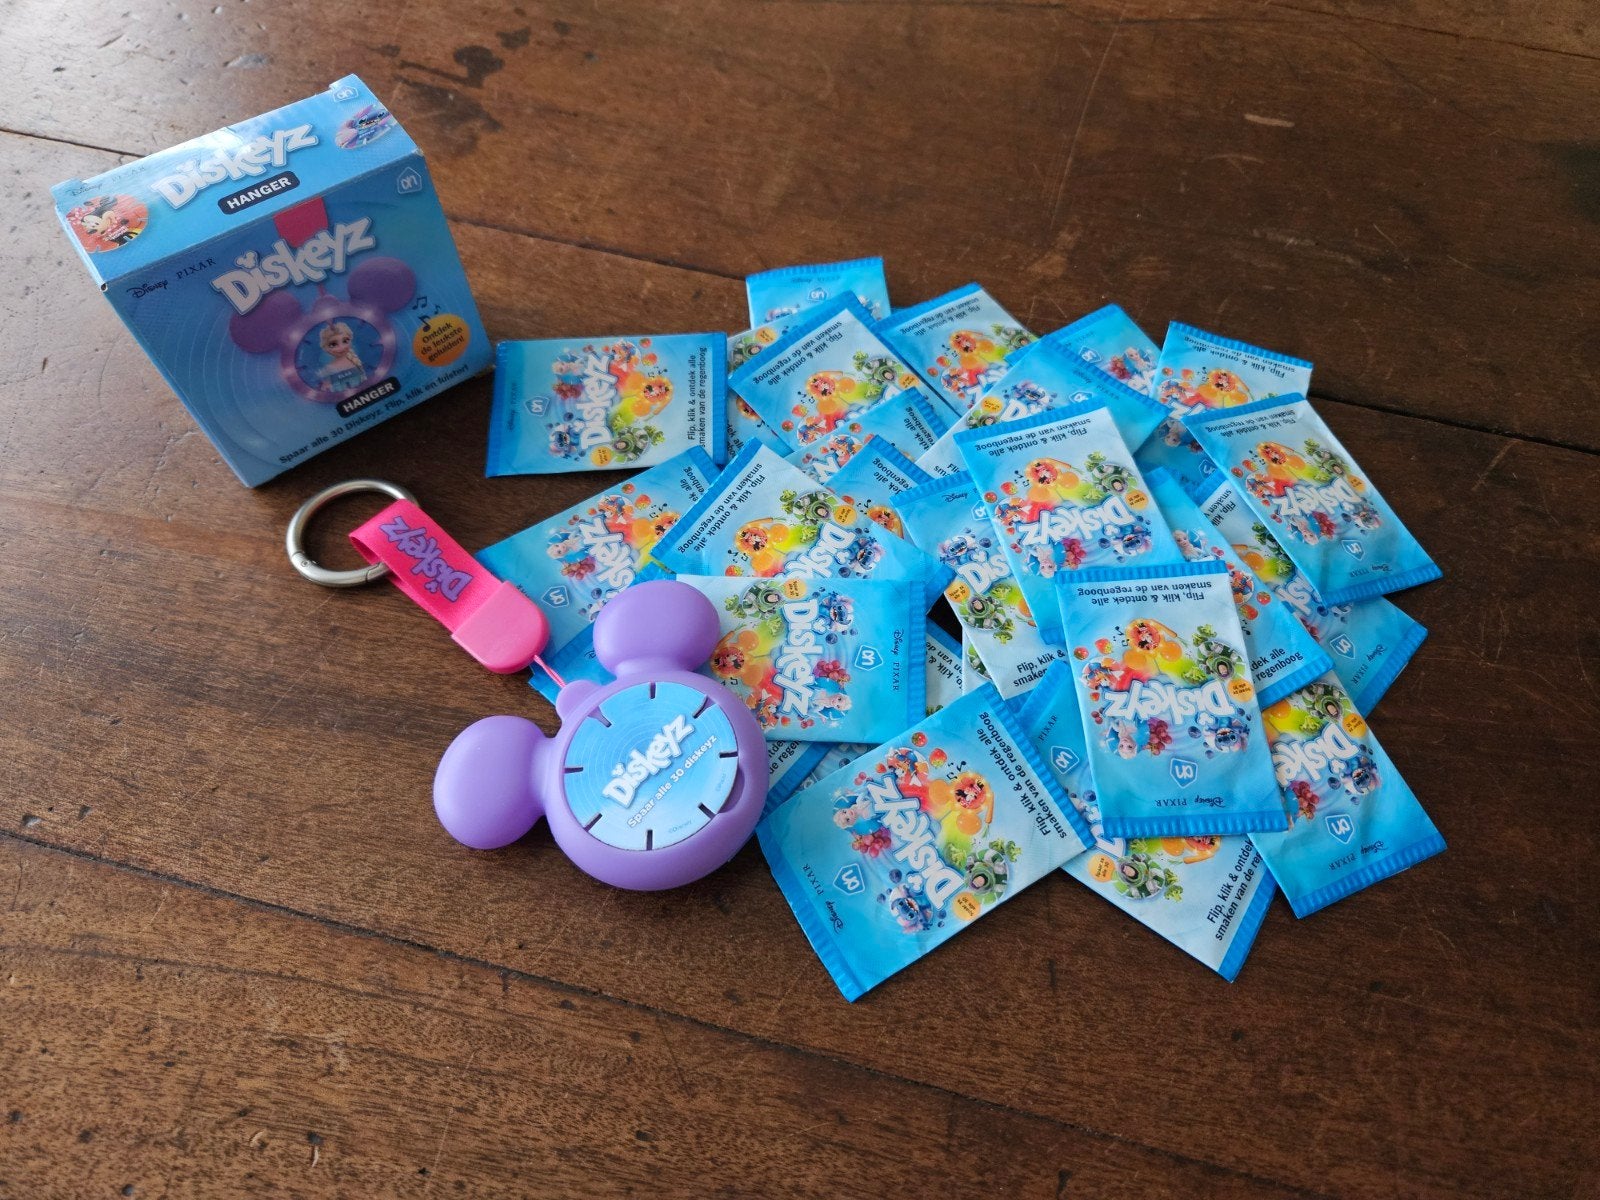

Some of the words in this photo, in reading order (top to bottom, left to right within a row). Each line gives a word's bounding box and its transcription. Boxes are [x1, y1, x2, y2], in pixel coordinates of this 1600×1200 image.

[149, 124, 319, 210] Diskeyz
[226, 176, 292, 210] HANGER
[209, 216, 376, 315] Diskeyz
[126, 279, 169, 298] Disney
[176, 257, 217, 279] PIXAR
[421, 322, 453, 344] Ontdek
[432, 326, 463, 350] leukste
[815, 321, 841, 341] smaken
[826, 330, 842, 344] Flip,
[801, 339, 814, 350] van
[813, 342, 827, 354] klik
[1191, 344, 1206, 353] alle
[687, 354, 696, 368] alle
[1209, 350, 1238, 362] ontdek
[698, 347, 709, 389] regenboog
[752, 355, 791, 384] regenboog
[781, 356, 806, 376] ontdek
[1250, 362, 1265, 371] klik
[1266, 366, 1284, 378] Flip,
[687, 368, 696, 398] ontdek
[767, 374, 781, 386] alle
[342, 382, 395, 413] HANGER
[577, 353, 619, 449] Diskeyz
[279, 444, 309, 464] Spaar
[311, 435, 330, 449] alle
[331, 426, 344, 438] 30
[406, 387, 424, 401] klik
[424, 382, 437, 393] en
[437, 364, 469, 385] luister!
[687, 407, 696, 422] klik
[687, 424, 697, 441] Flip,
[698, 415, 707, 448] smaken
[902, 417, 915, 432] alle
[1037, 427, 1053, 435] van
[1057, 418, 1090, 432] smaken
[1067, 426, 1087, 437] Flip,
[974, 434, 1022, 452] regenboog
[1006, 439, 1038, 452] ontdek
[1025, 432, 1035, 440] de
[1039, 436, 1047, 444] &
[1049, 432, 1065, 441] klik
[988, 447, 1004, 457] alle
[678, 478, 691, 492] alle
[682, 466, 704, 494] enboog
[736, 462, 762, 491] smaken
[749, 473, 765, 490] Flip,
[873, 470, 888, 484] alle
[723, 490, 736, 504] van
[736, 488, 751, 504] klik
[1208, 488, 1232, 513] smaken
[1274, 478, 1361, 517] Diskeyz
[714, 504, 725, 515] de
[730, 503, 738, 511] &
[1219, 500, 1235, 516] Flip,
[707, 510, 731, 537] ontdek
[1017, 495, 1134, 546] Diskeyz
[677, 513, 715, 555] regenboog
[579, 513, 637, 590] skeyz
[693, 537, 708, 552] alle
[784, 522, 856, 579] Disk
[379, 516, 474, 602] Diskeyz
[1077, 584, 1131, 596] regenboog
[1135, 585, 1147, 593] de
[1171, 581, 1211, 591] smaken
[1183, 590, 1204, 600] Flip,
[1091, 597, 1109, 605] alle
[1112, 595, 1147, 604] ontdek
[1151, 594, 1158, 602] &
[1162, 593, 1180, 602] klik
[890, 629, 904, 655] Disney
[775, 599, 826, 716] Diskeyz
[936, 650, 953, 665] van
[1016, 658, 1037, 675] Flip,
[1037, 650, 1055, 665] klik
[1055, 648, 1064, 657] &
[1268, 645, 1285, 660] alle
[935, 662, 953, 679] klik
[1254, 649, 1303, 682] regenboog
[1351, 663, 1369, 685] PIXAR
[891, 662, 900, 691] PIXAR
[1103, 680, 1234, 724] Diskeyz
[975, 727, 991, 746] alle
[978, 710, 1017, 764] regenboog
[1039, 715, 1058, 741] PIXAR
[601, 714, 695, 809] Diskeyz
[988, 746, 1015, 782] ontdek
[1273, 723, 1359, 787] Diske
[1013, 764, 1025, 778] de
[626, 799, 656, 828] Spaar
[655, 781, 673, 801] alle
[670, 767, 685, 783] 30
[684, 734, 718, 771] diskeyz
[1013, 782, 1022, 792] &
[1024, 778, 1039, 797] van
[1019, 793, 1035, 812] klik
[1155, 798, 1187, 807] PIXAR
[1194, 796, 1226, 808] Disney
[1032, 811, 1052, 835] Flip,
[1035, 798, 1066, 840] smaken
[865, 771, 966, 910] Diskeyz
[1361, 840, 1388, 855] Disney
[1329, 855, 1357, 871] PIXAR
[802, 864, 824, 895] PIXAR
[1206, 901, 1225, 924] Flip,
[1217, 881, 1234, 901] klik
[1228, 872, 1239, 882] &
[1211, 900, 1239, 940] smaken
[1233, 882, 1248, 900] van
[1241, 866, 1255, 881] de
[826, 900, 844, 934] Disney
